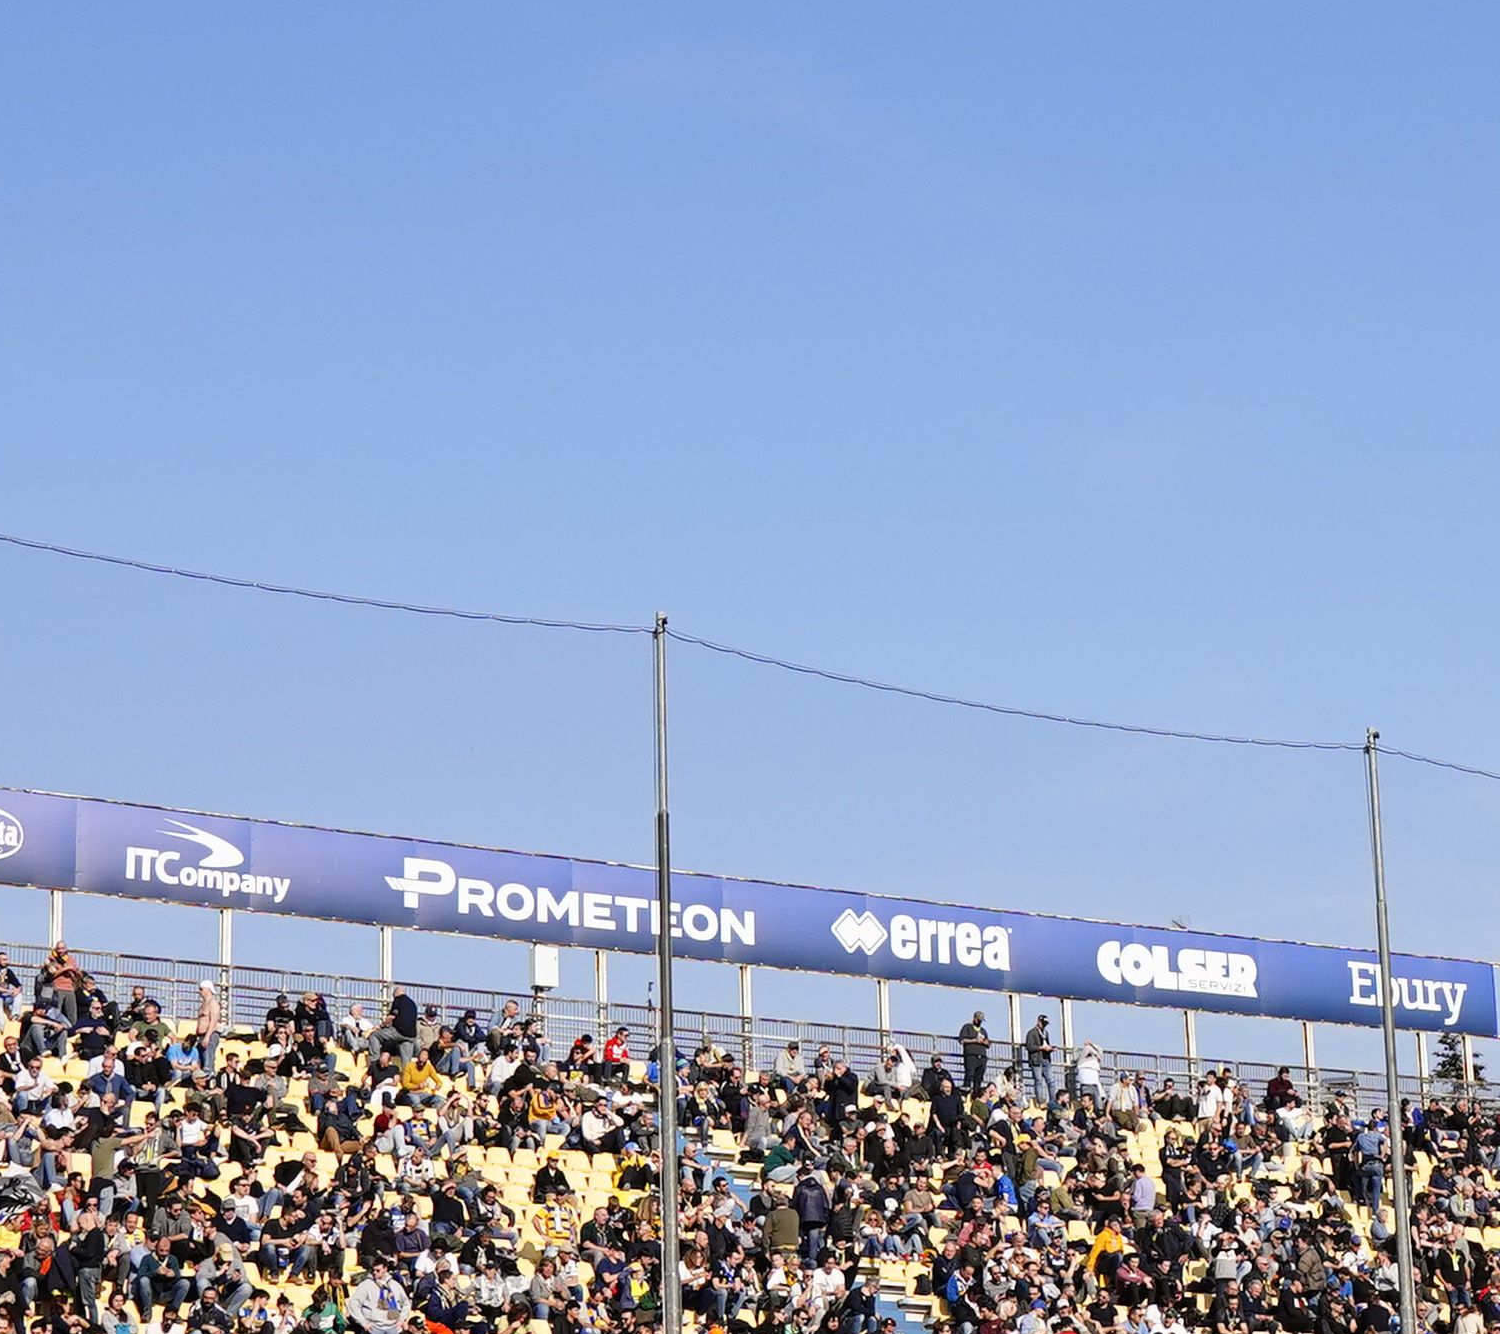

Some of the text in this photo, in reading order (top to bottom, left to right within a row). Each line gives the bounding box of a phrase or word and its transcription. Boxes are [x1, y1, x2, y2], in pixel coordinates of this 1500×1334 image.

[125, 846, 291, 904] ITCompany
[1096, 940, 1259, 999] COLSER
[1187, 978, 1247, 994] SERVIZI
[1348, 960, 1467, 1026] Ebury
